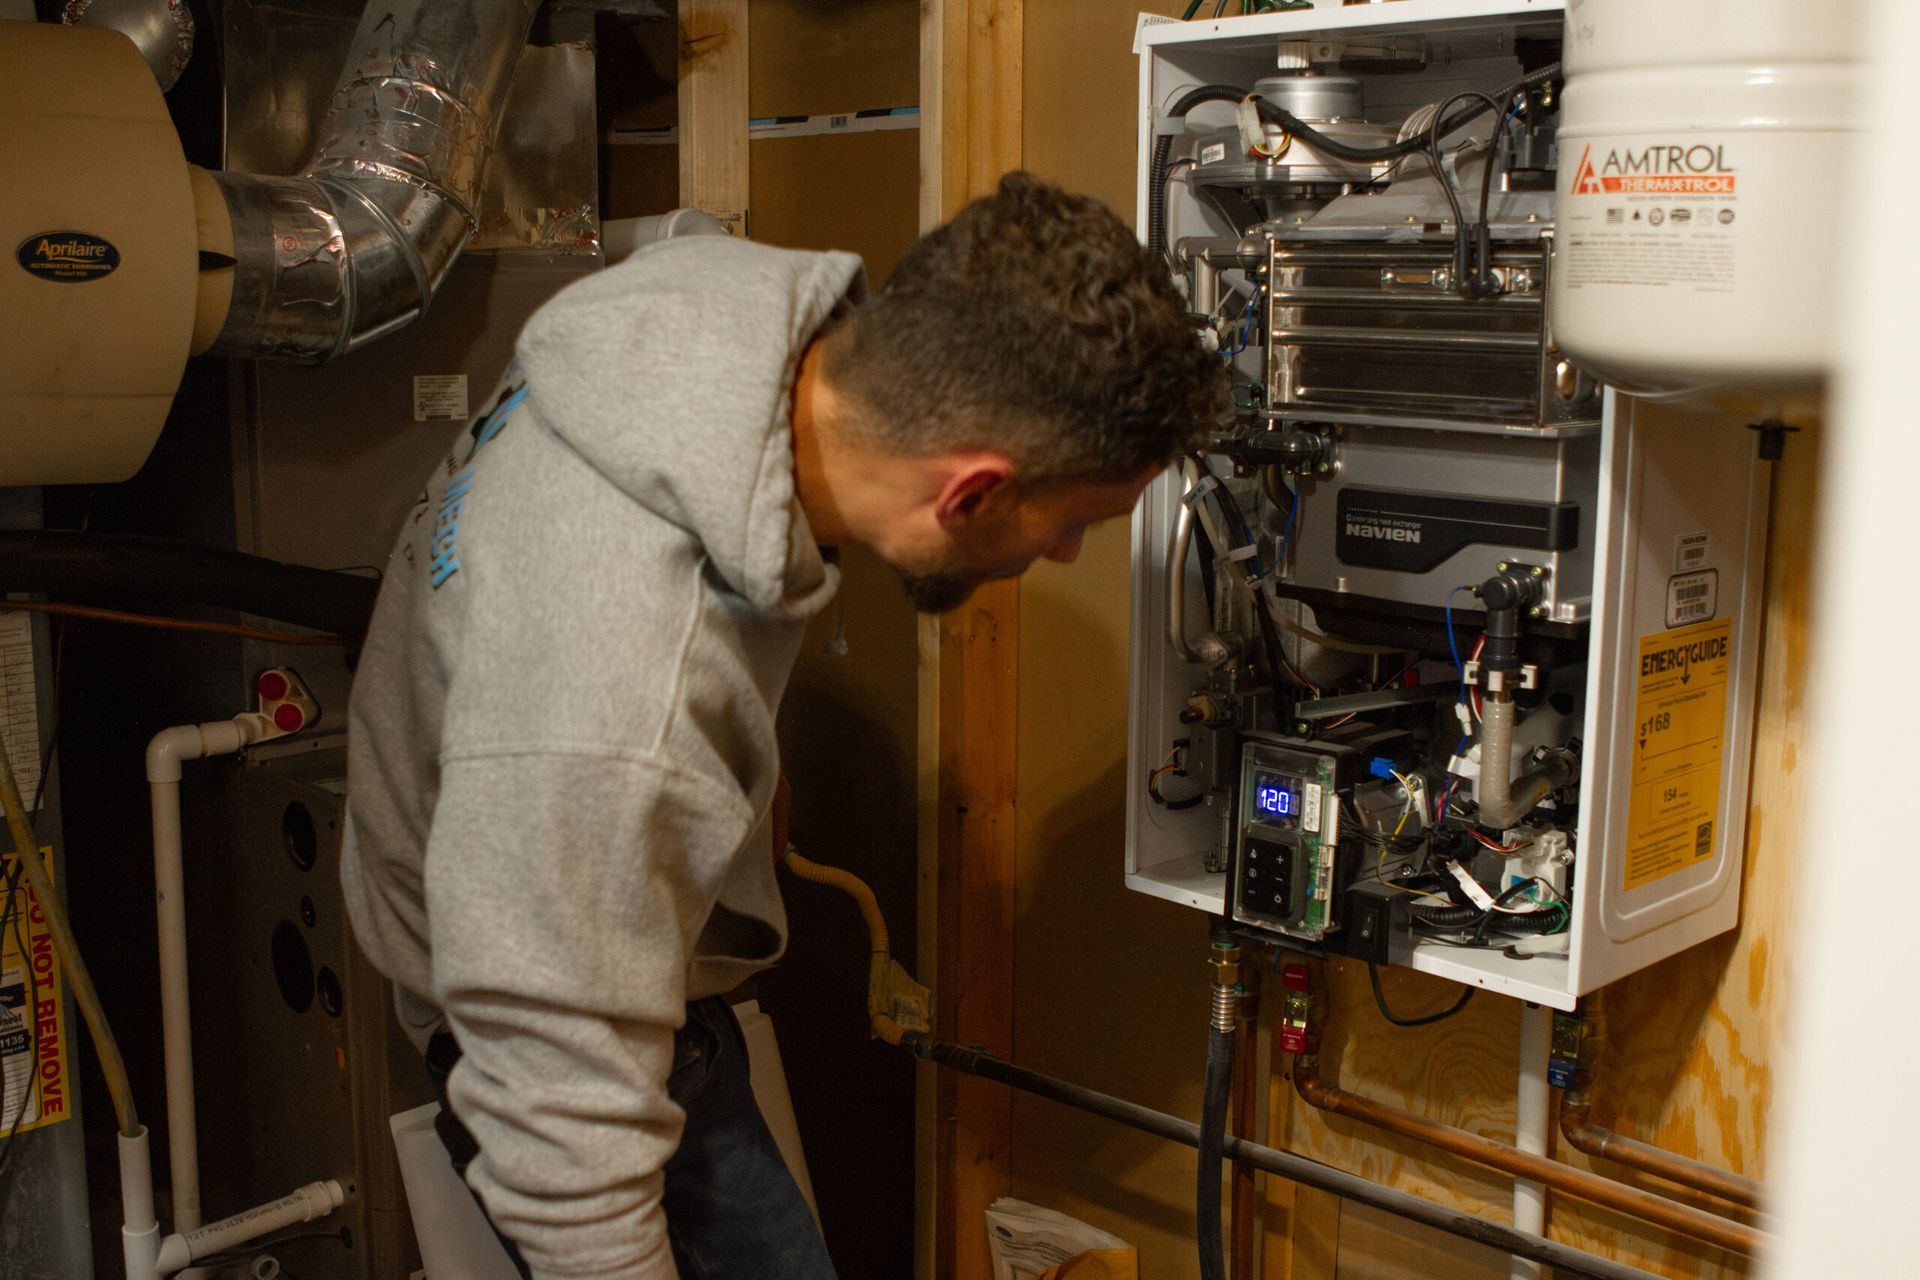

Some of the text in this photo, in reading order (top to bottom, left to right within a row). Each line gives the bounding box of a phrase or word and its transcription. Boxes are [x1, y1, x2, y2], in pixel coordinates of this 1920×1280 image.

[1602, 145, 1733, 175] AMTROL
[36, 238, 106, 259] Aprilaire
[1641, 636, 1728, 676] ENERGYGUIDE
[1640, 711, 1671, 737] $168
[1261, 788, 1289, 814] 120
[32, 932, 55, 990] NOT
[37, 996, 63, 1117] REMOVE
